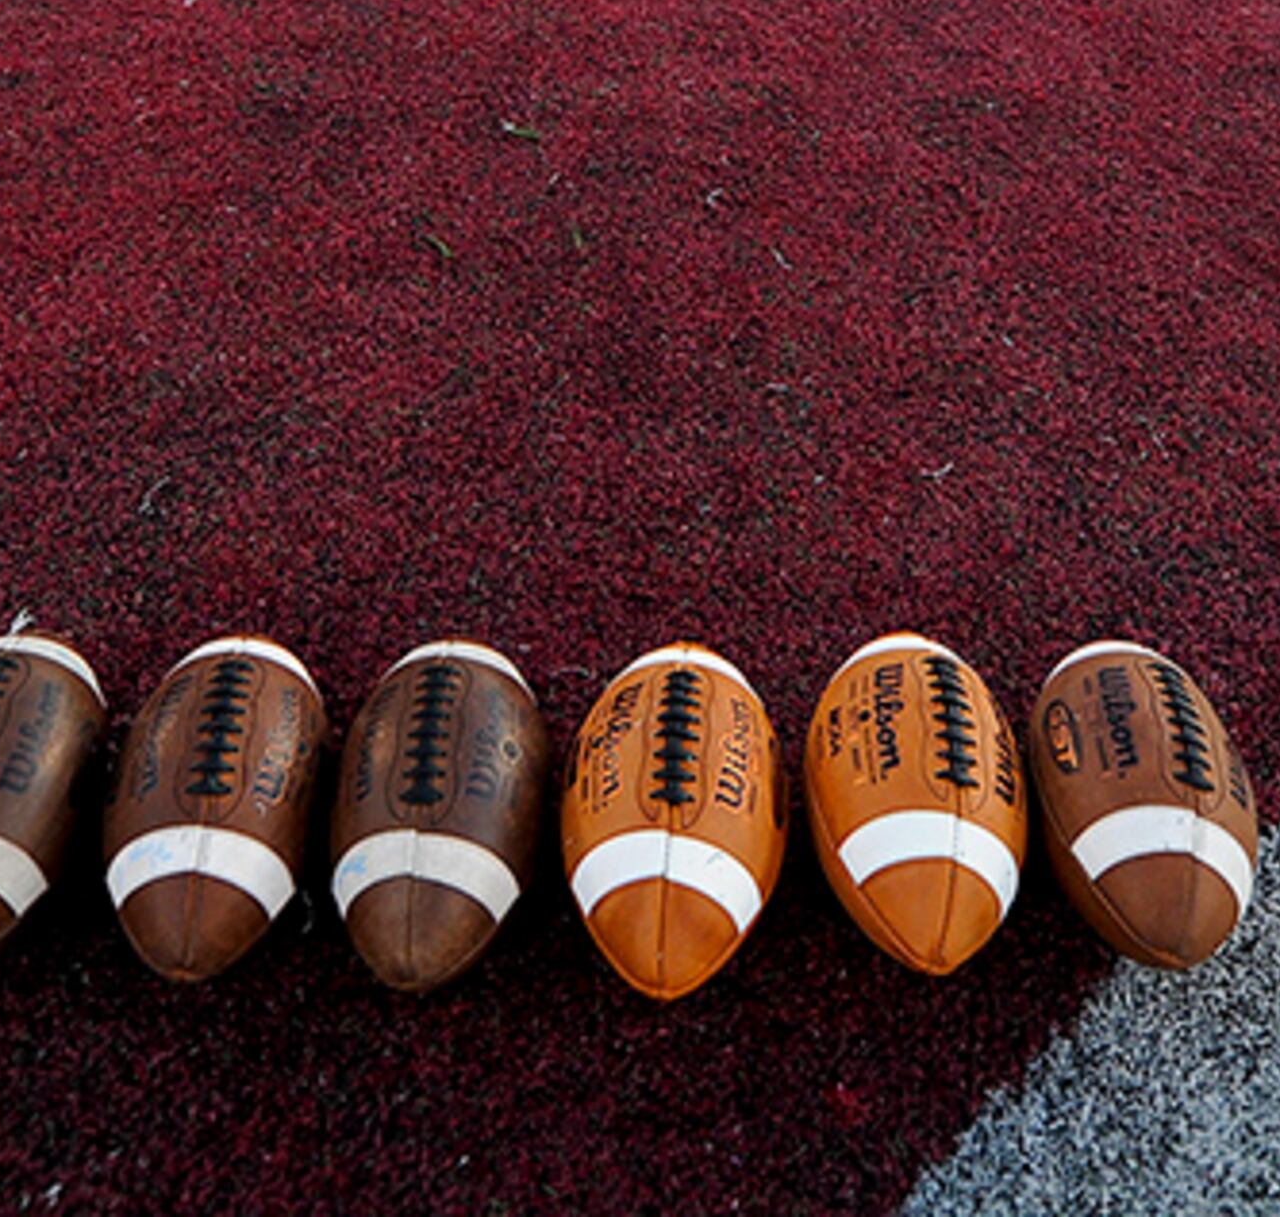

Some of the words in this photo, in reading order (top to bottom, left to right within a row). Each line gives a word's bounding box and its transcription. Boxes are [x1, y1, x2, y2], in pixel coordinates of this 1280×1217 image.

[251, 688, 300, 810] Wilson
[714, 696, 751, 810] Wilson
[874, 662, 906, 779] Wilson
[1097, 666, 1140, 779] Wilson
